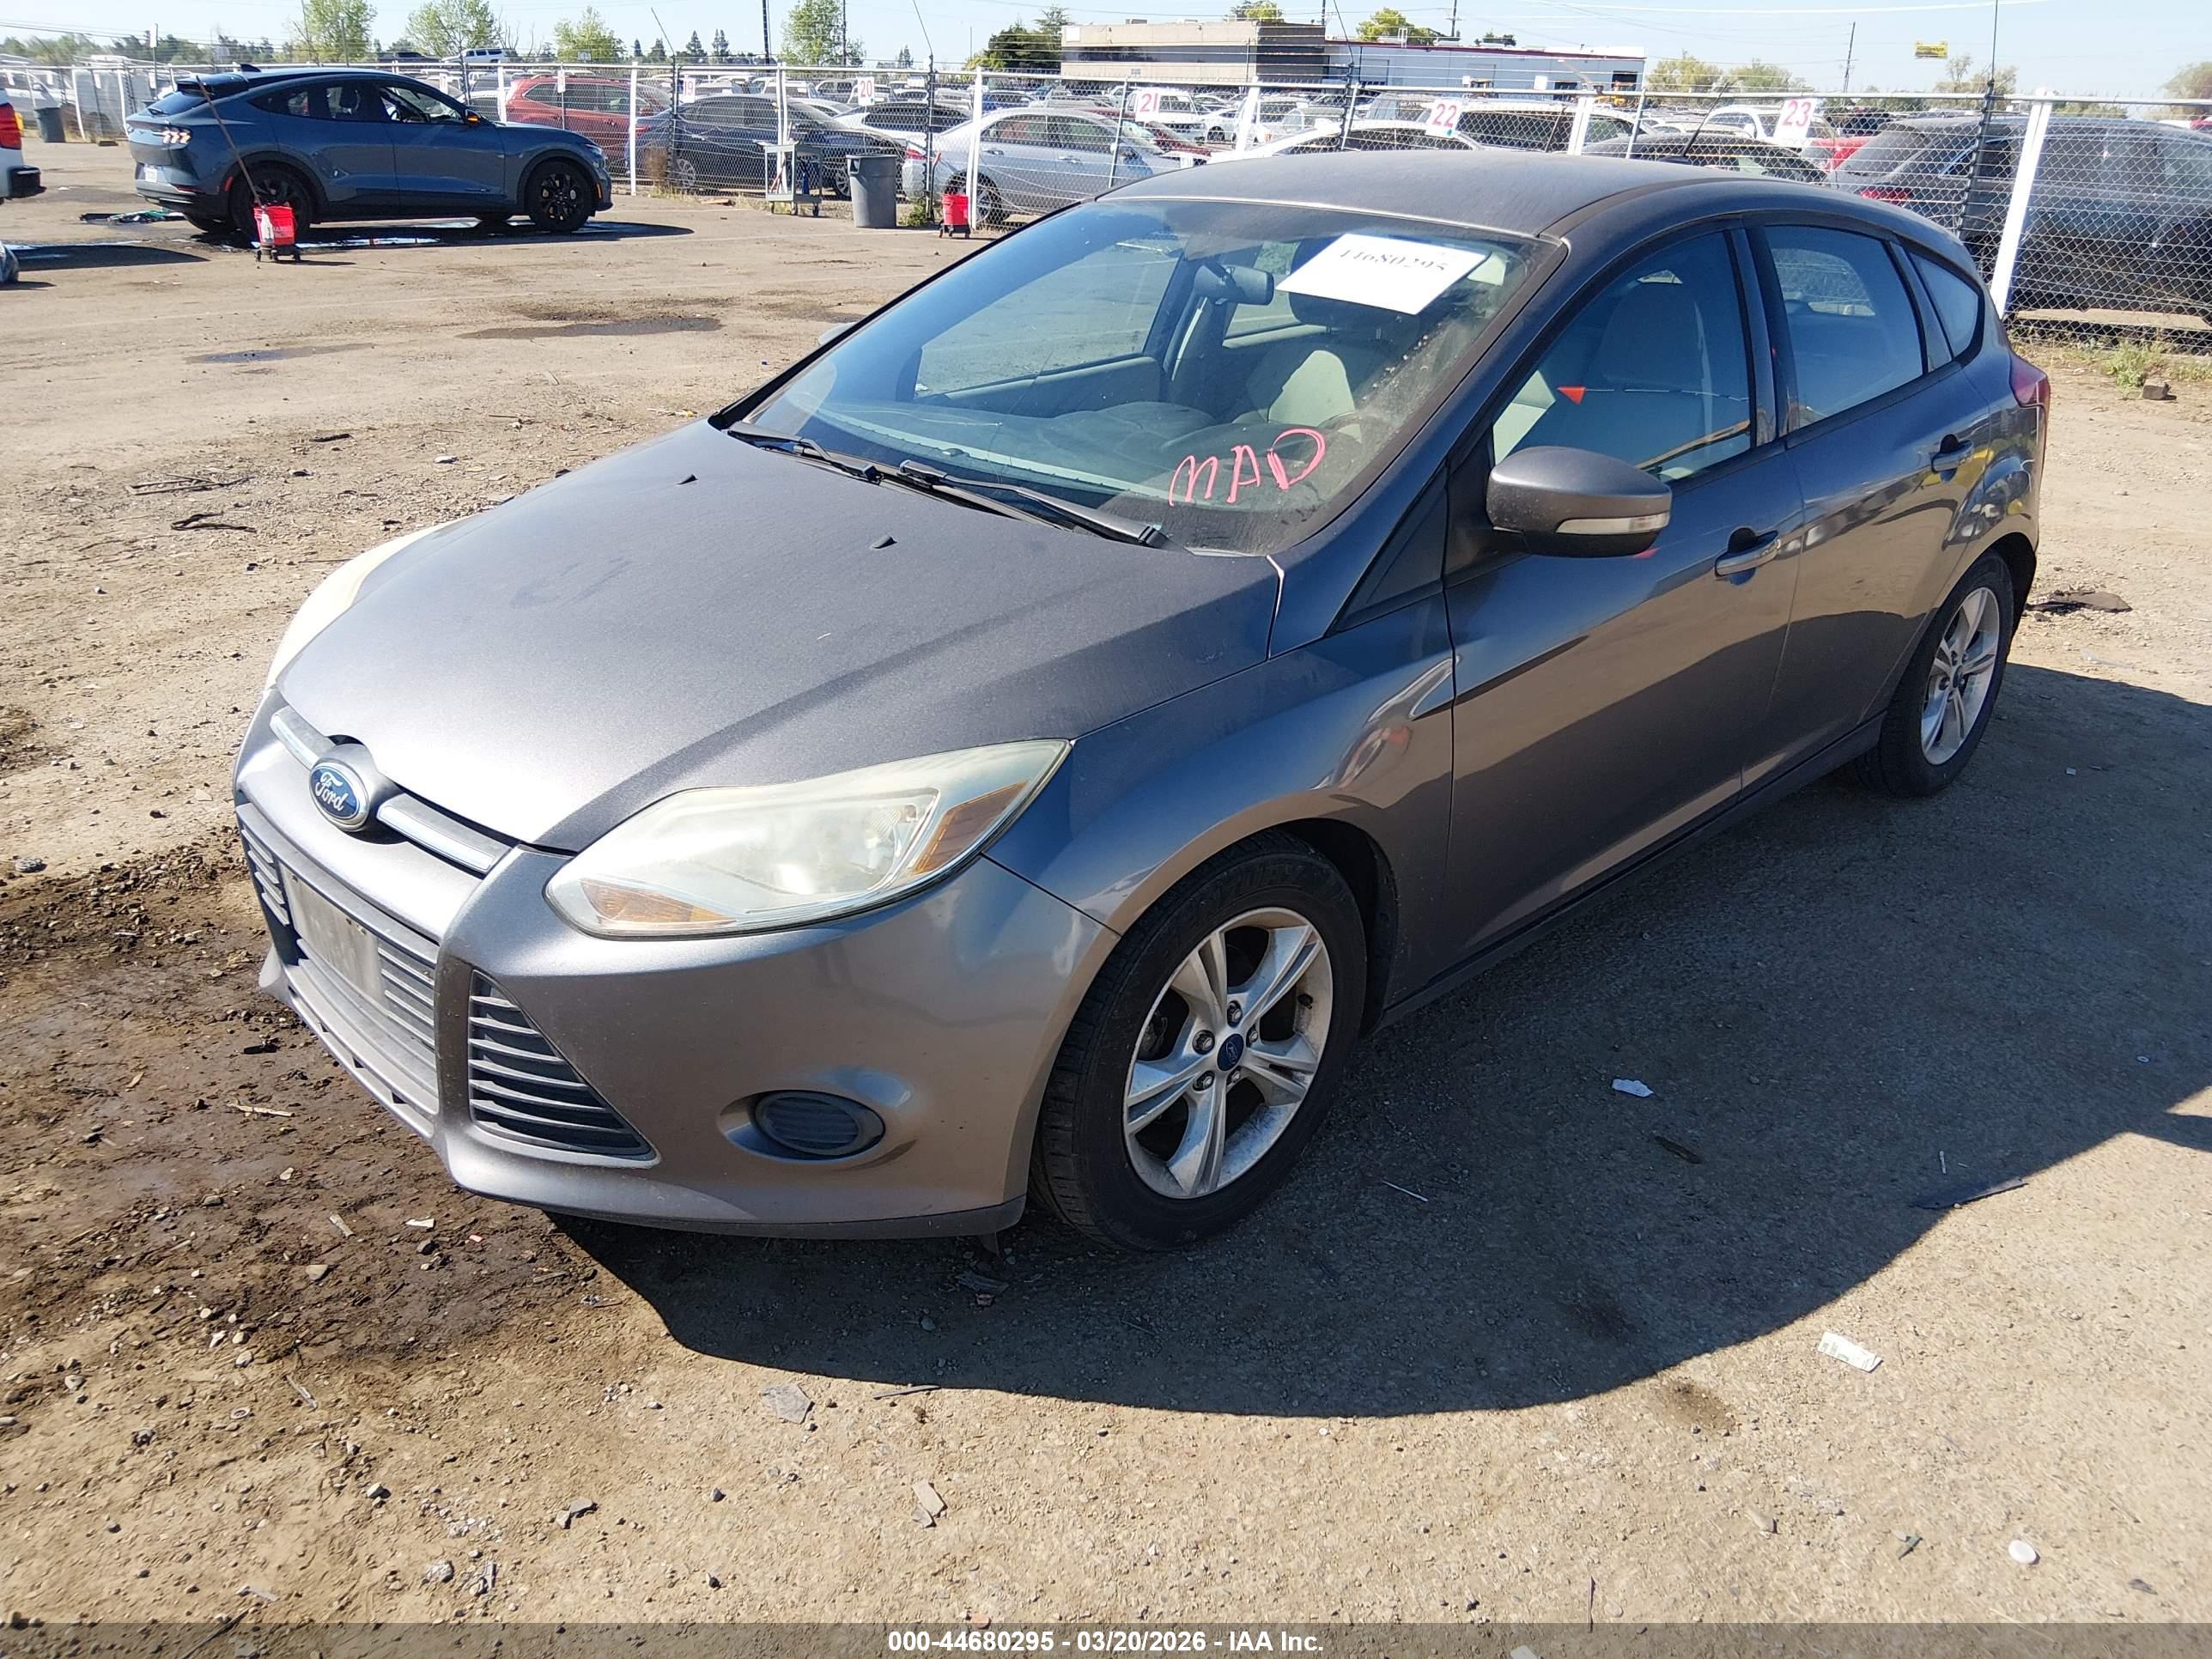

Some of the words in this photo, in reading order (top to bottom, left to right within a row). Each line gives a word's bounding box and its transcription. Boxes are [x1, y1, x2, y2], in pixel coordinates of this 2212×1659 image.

[684, 81, 694, 96] 19
[860, 80, 872, 97] 20
[1139, 93, 1158, 112] 21
[1781, 100, 1812, 127] 23
[1431, 103, 1457, 128] 22
[314, 771, 349, 811] Ford
